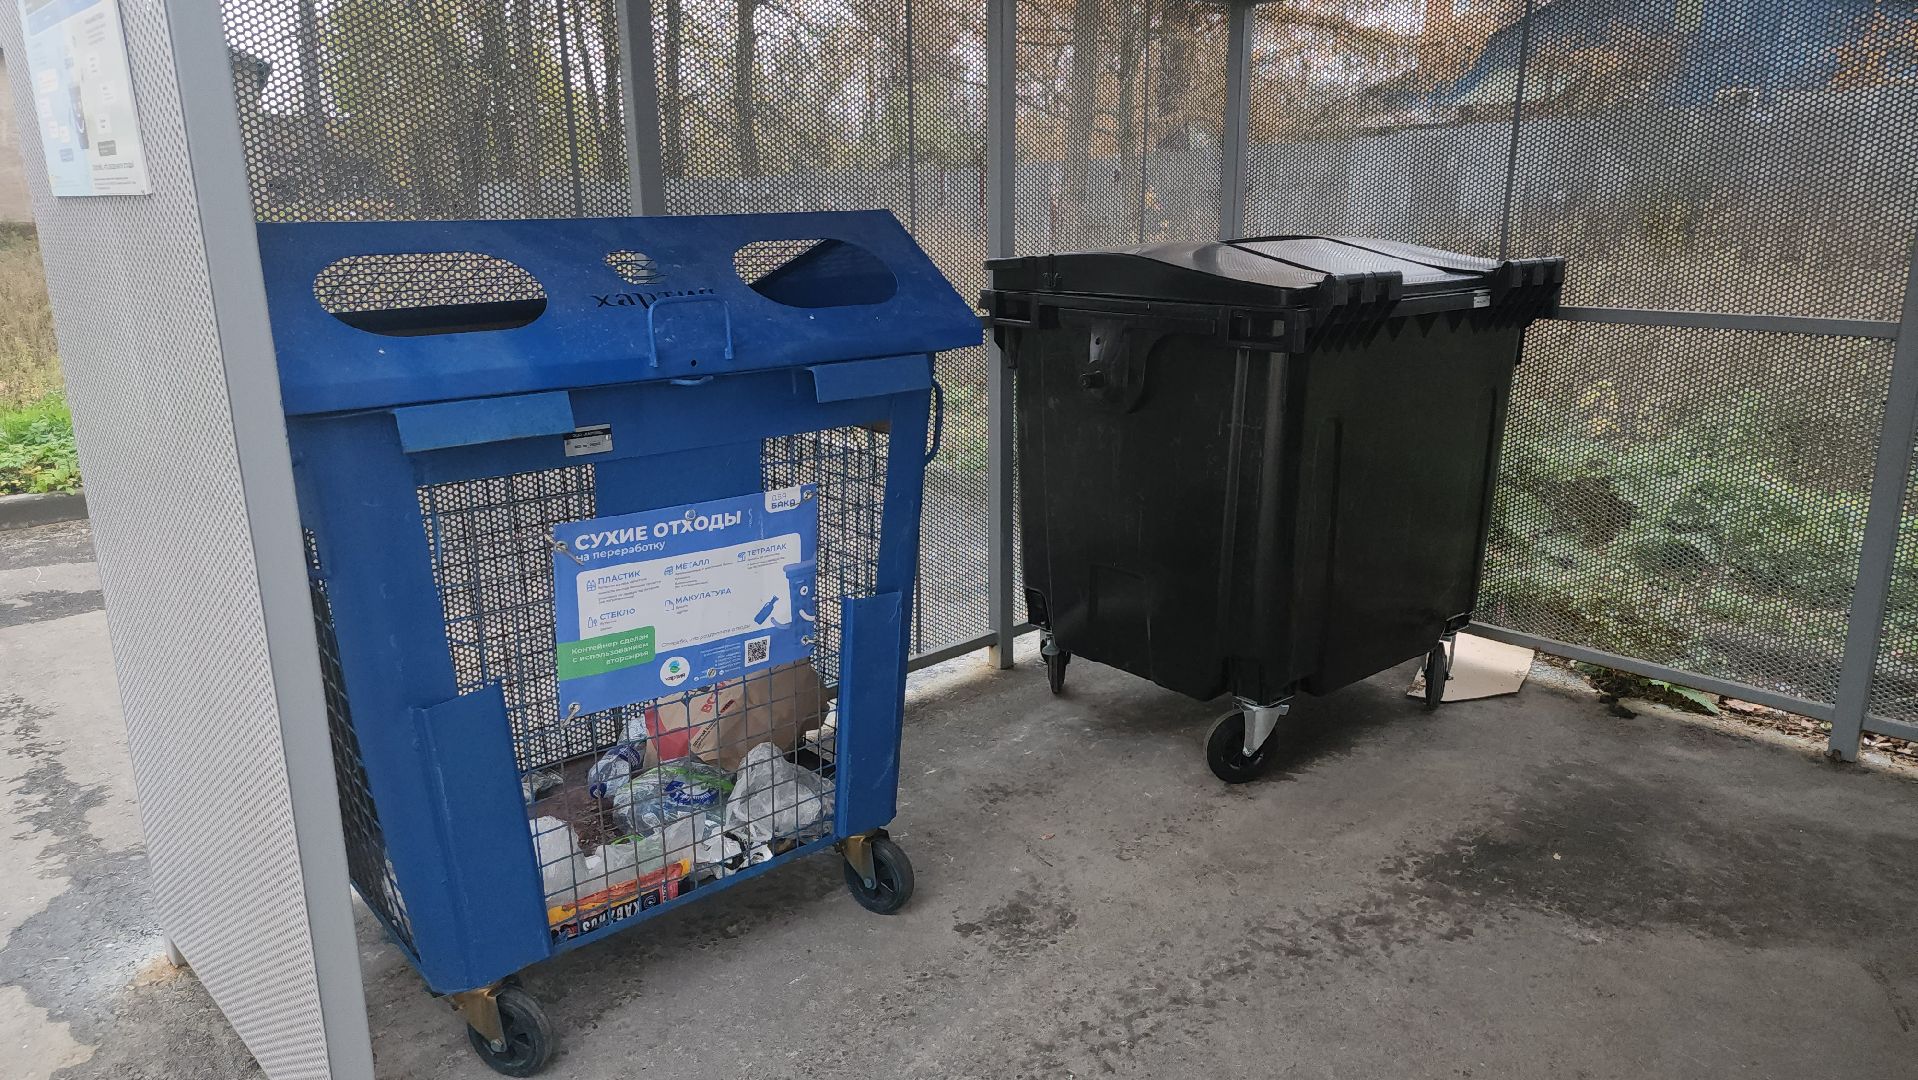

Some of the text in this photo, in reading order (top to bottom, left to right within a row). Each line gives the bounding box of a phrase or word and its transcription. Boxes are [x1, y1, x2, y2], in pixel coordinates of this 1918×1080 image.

[574, 510, 742, 551] СУХИЕ ОТХОДЫ
[592, 541, 666, 560] переработку
[747, 543, 787, 557] ТЕТРАПАК
[597, 570, 641, 585] ПЛАСТИК
[599, 608, 636, 621] СТЕКЛО
[571, 633, 649, 655] Контейнер сделан
[579, 642, 649, 662] использованием
[606, 651, 649, 665] вторсырья
